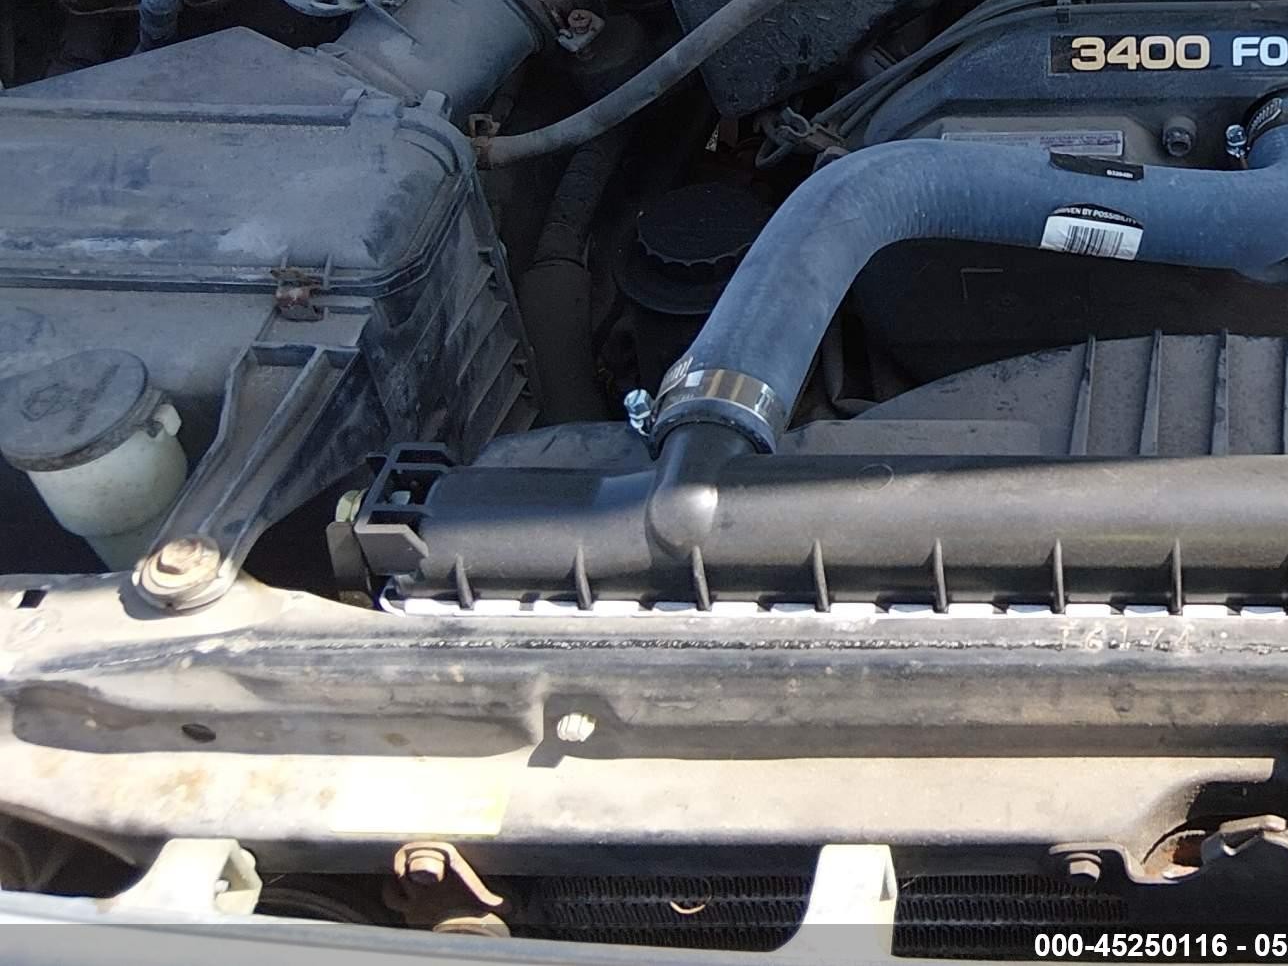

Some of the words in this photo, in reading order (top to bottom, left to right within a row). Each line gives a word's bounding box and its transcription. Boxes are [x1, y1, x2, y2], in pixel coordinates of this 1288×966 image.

[1071, 35, 1211, 71] 3400
[1082, 208, 1092, 216] BY
[1093, 210, 1137, 224] POSSIBILITY
